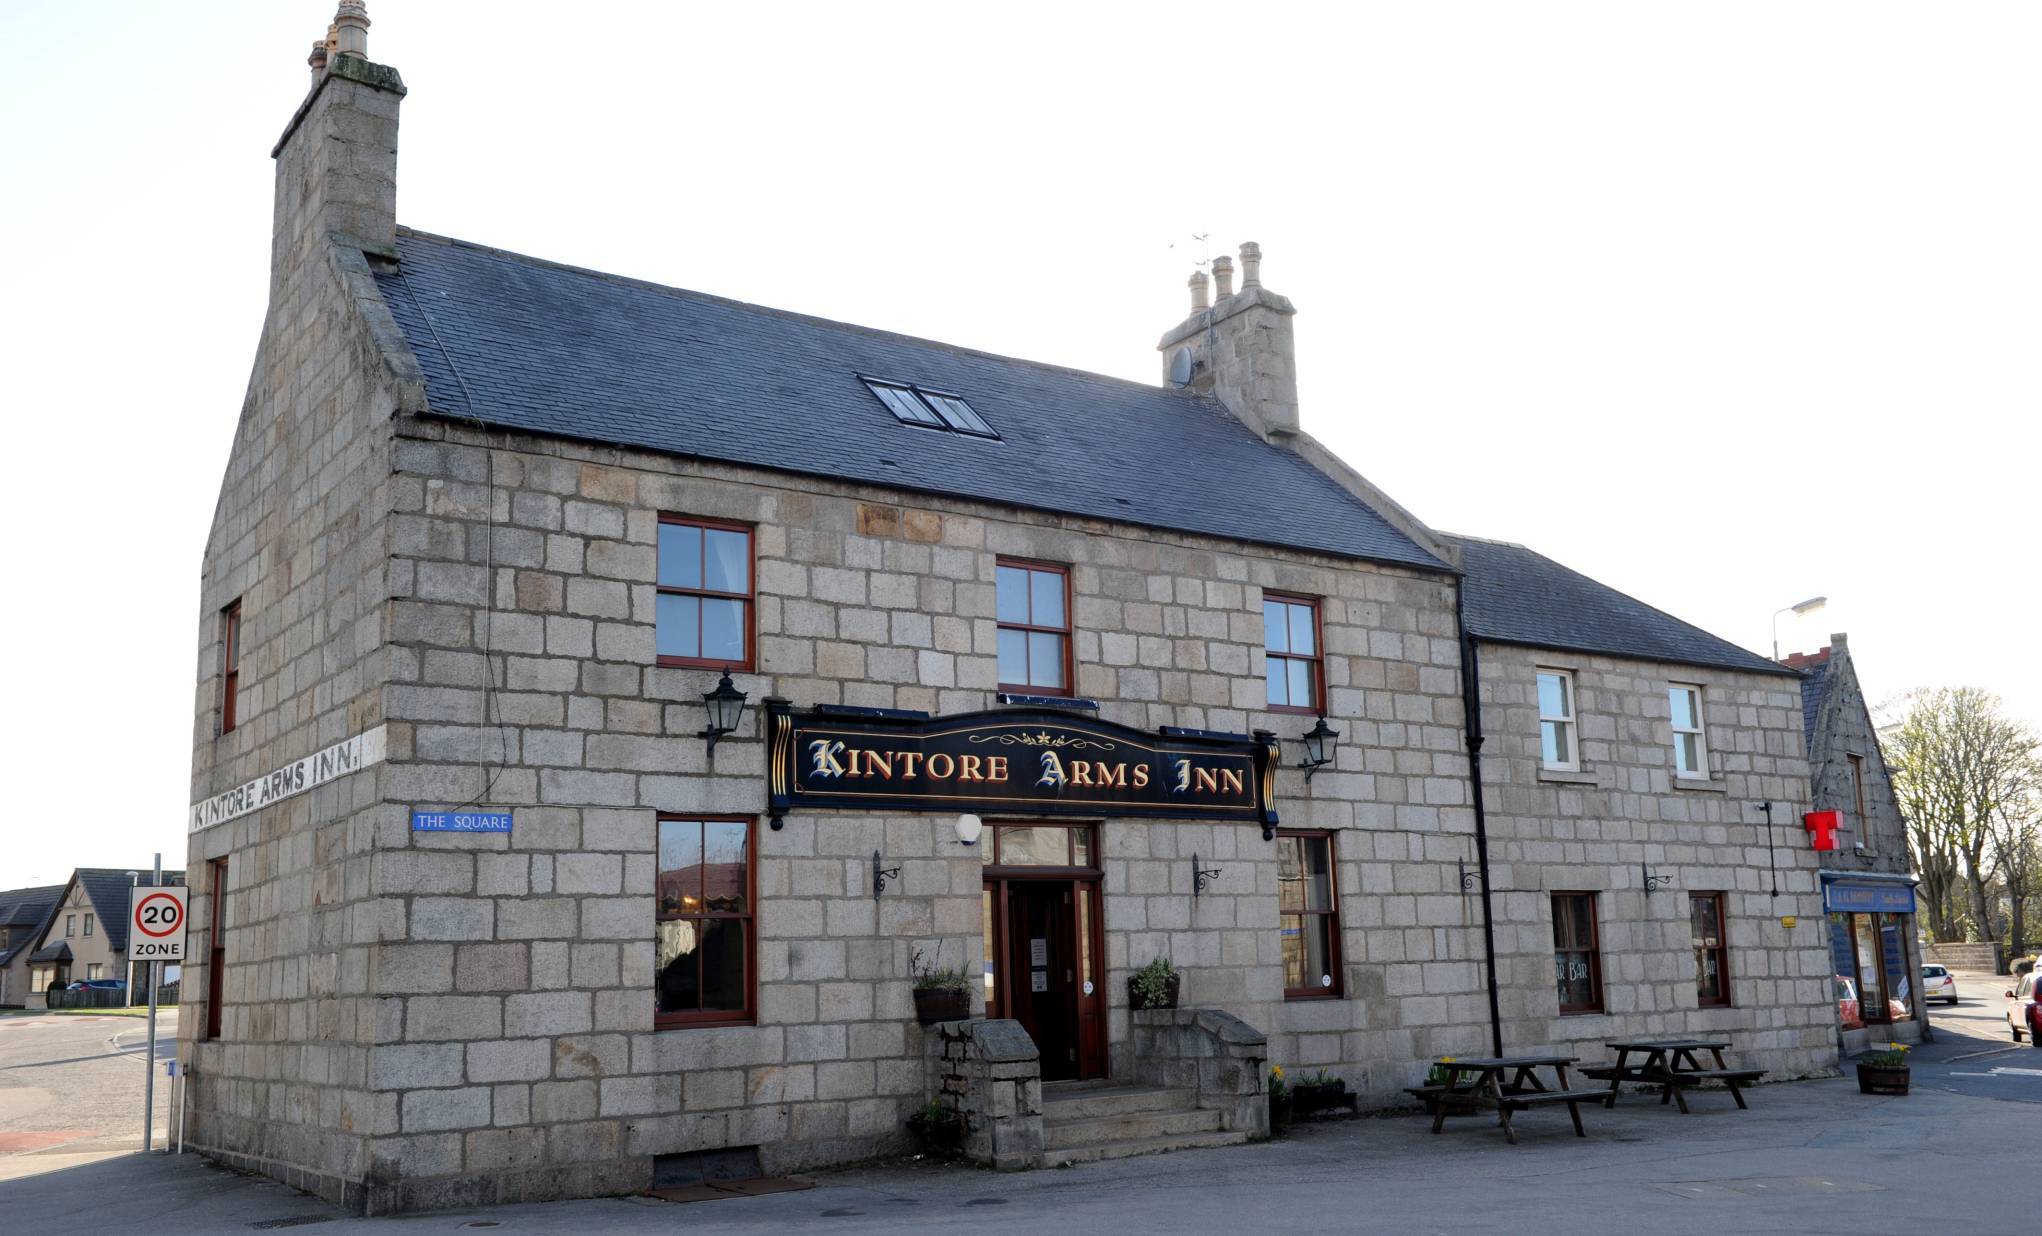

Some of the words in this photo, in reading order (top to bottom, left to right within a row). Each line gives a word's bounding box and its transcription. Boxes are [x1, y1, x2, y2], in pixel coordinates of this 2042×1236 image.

[809, 740, 1009, 783] KINTORE
[1035, 751, 1150, 789] ARMS
[1172, 759, 1245, 795] INN
[194, 783, 256, 829] KINTORE
[260, 761, 304, 805] ARMS
[417, 815, 446, 828] THE
[454, 815, 508, 830] SQUARE
[144, 906, 177, 924] 20
[136, 943, 179, 955] ZONE
[1568, 962, 1588, 981] BAR
